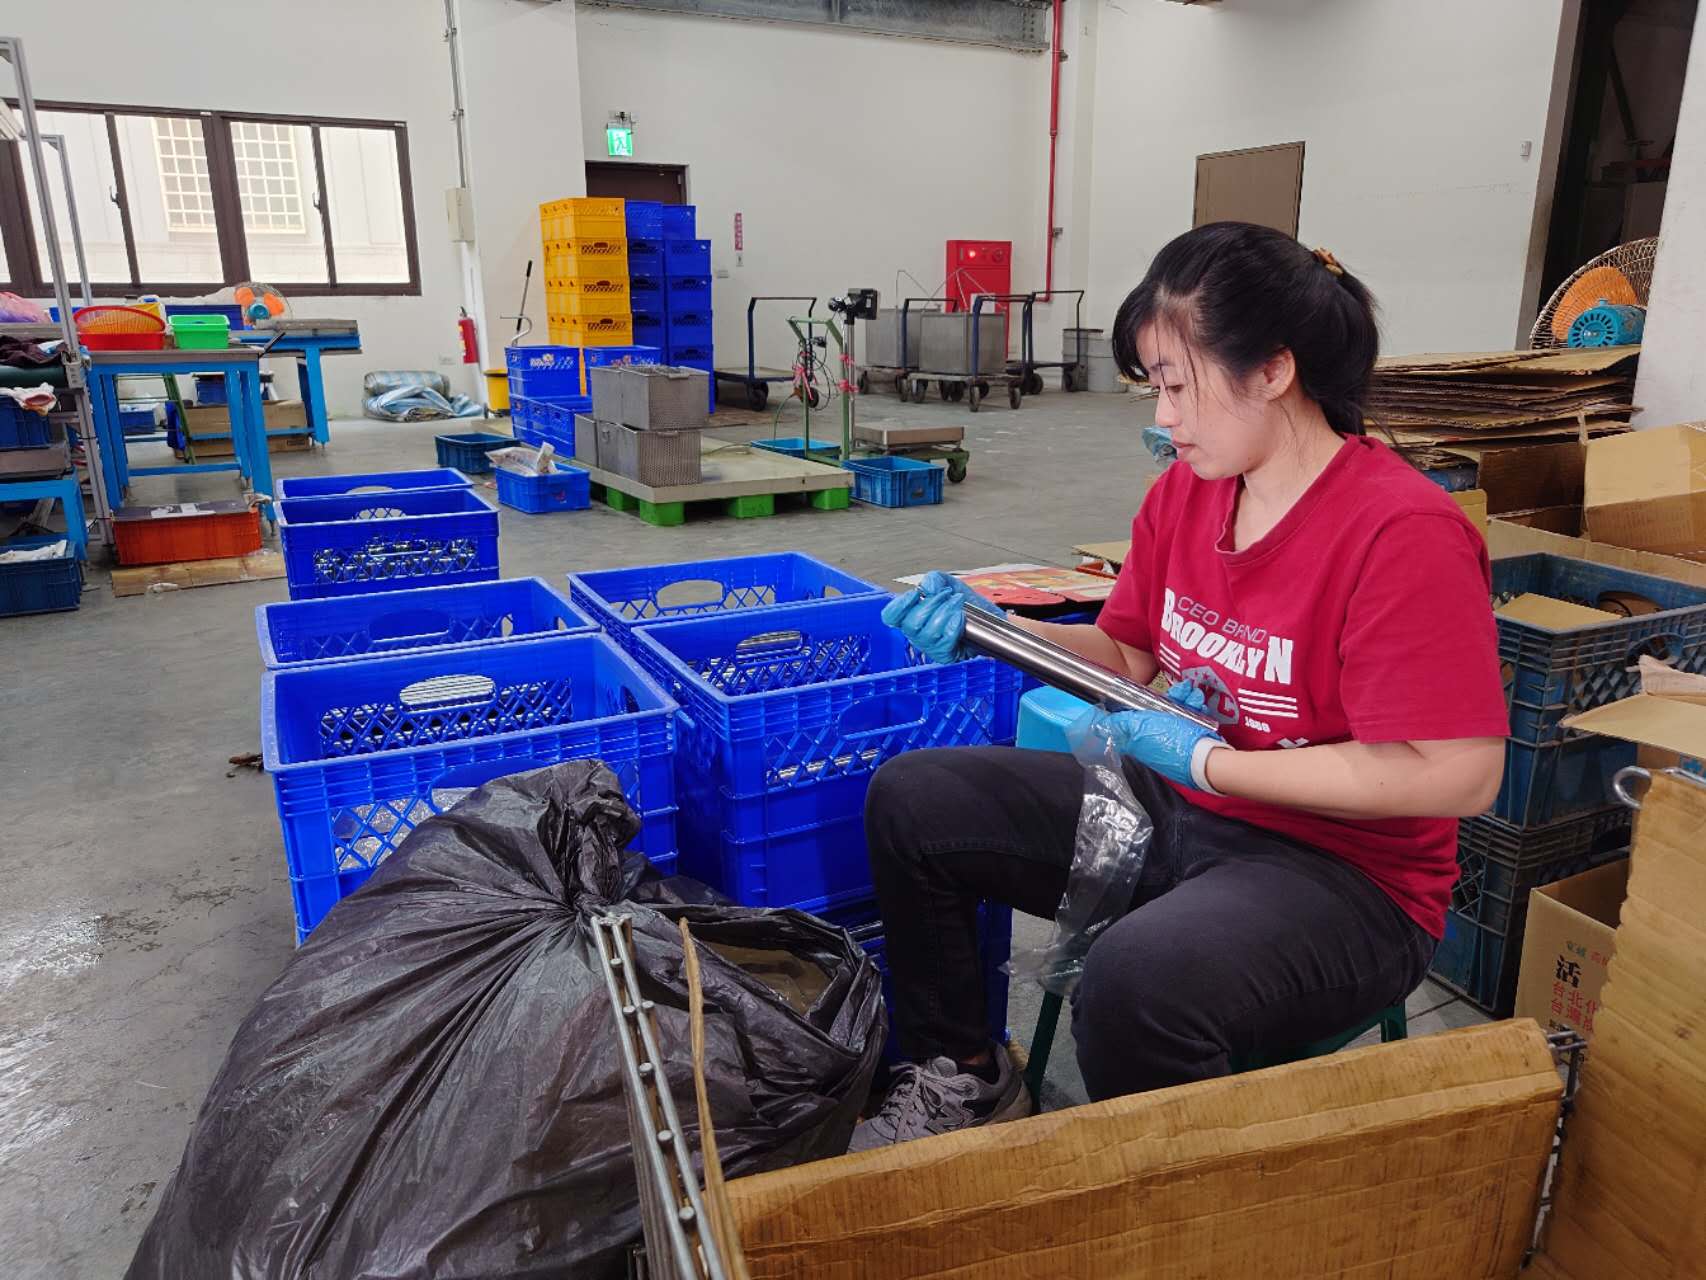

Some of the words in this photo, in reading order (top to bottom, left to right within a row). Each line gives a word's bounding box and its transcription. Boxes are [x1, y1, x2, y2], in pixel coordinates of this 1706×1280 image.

[1177, 596, 1220, 626] CEO
[1161, 587, 1293, 685] BROOKLYN
[1555, 954, 1581, 988] 活
